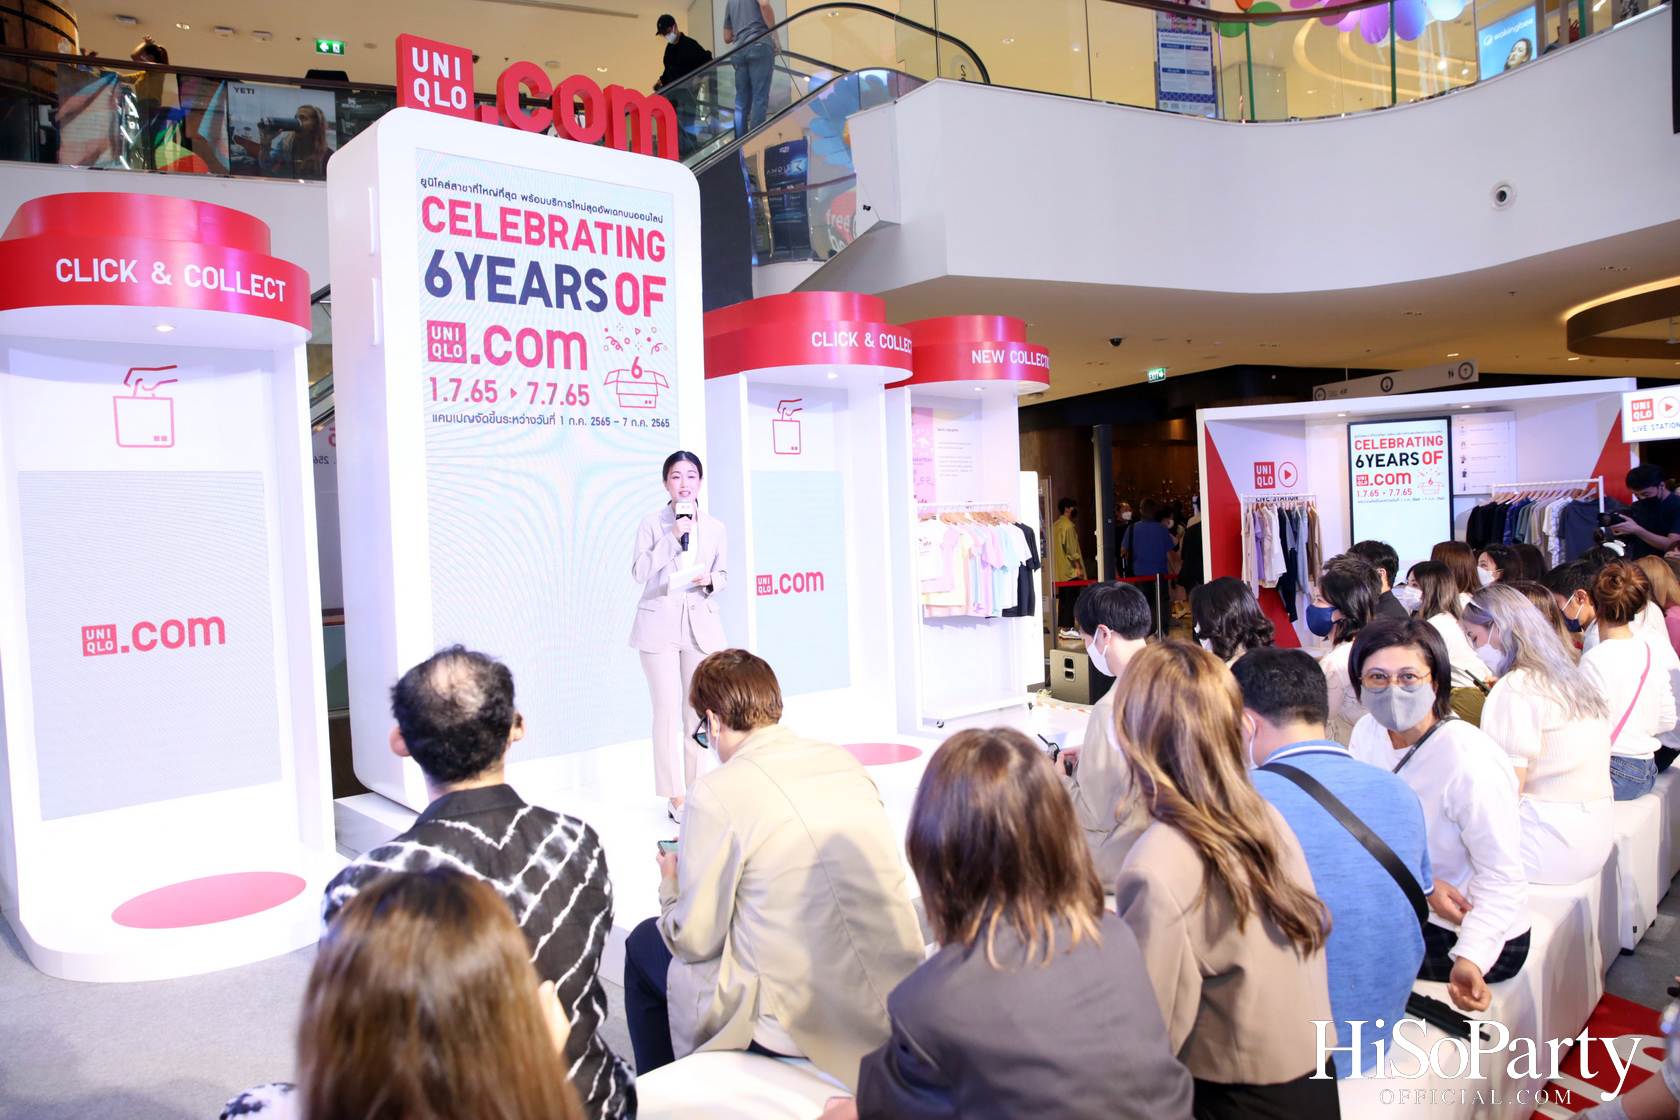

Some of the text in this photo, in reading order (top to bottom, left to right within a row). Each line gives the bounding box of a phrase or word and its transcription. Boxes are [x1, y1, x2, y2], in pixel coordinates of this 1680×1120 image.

[412, 47, 461, 81] UNI
[233, 86, 255, 95] YETI
[414, 78, 467, 110] QLO
[475, 61, 680, 162] .com
[421, 195, 666, 263] CELEBRATING
[55, 257, 286, 302] CLICK & COLLECT
[614, 271, 667, 318] OF
[431, 325, 460, 342] UNI
[470, 324, 588, 371] .com
[811, 331, 912, 354] CLICK & COLLEC
[431, 343, 463, 359] QLO
[971, 349, 1006, 364] NEW
[429, 376, 590, 407] 1.7.65 7.7.65
[1632, 400, 1651, 411] UNI
[560, 416, 564, 425] 1
[590, 416, 611, 427] 2565
[622, 417, 628, 427] 7
[651, 418, 670, 428] 2565
[1632, 424, 1648, 433] LIVE
[1354, 435, 1444, 451] CELEBRATING
[1421, 450, 1444, 465] OF
[1256, 464, 1272, 475] UNI
[1256, 476, 1274, 488] QLO
[1369, 472, 1412, 486] .com
[1356, 487, 1413, 498] 1.7.65 7.7.65
[757, 576, 770, 585] UNI
[773, 571, 825, 595] .com
[757, 585, 771, 595] QLO
[85, 627, 111, 640] UNI
[120, 616, 226, 654] .com
[86, 640, 114, 655] QLO
